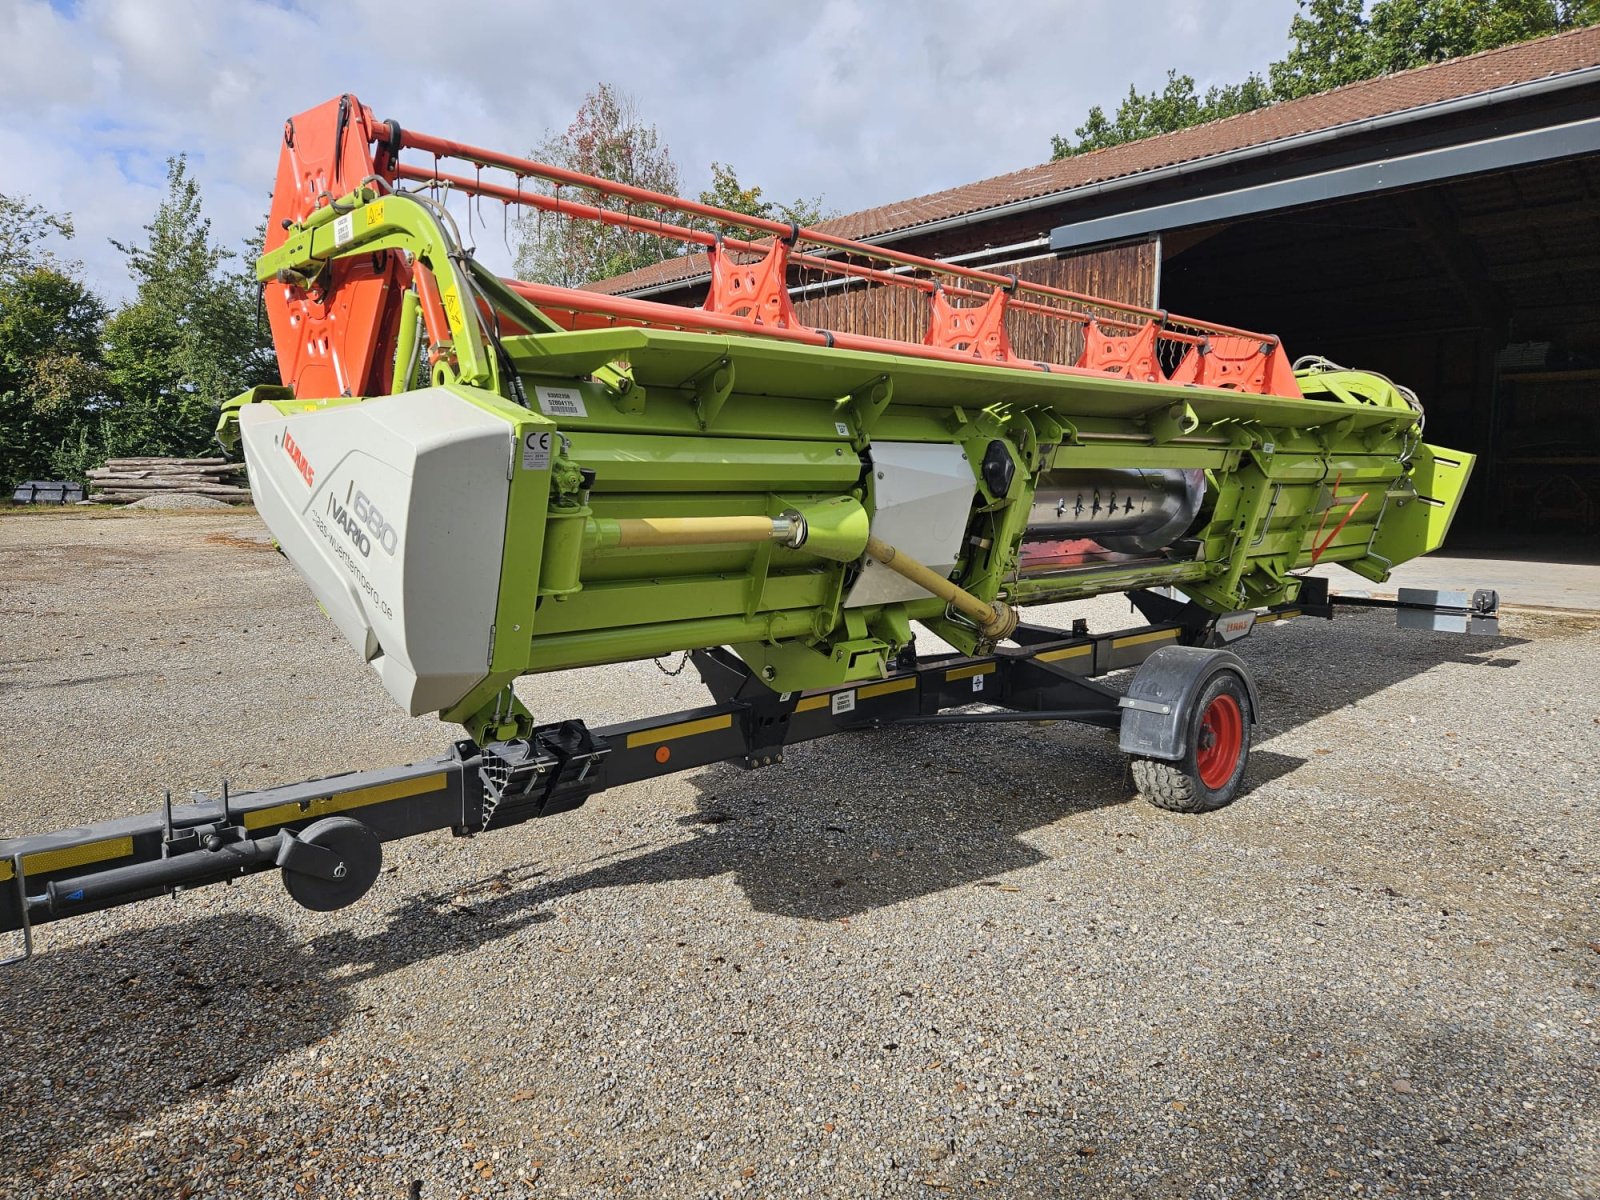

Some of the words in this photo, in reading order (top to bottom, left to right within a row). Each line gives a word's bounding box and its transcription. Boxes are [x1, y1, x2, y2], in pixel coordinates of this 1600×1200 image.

[284, 431, 315, 488] CLAAS
[526, 432, 549, 450] CE
[332, 497, 371, 558] VARIO
[353, 490, 398, 557] 680
